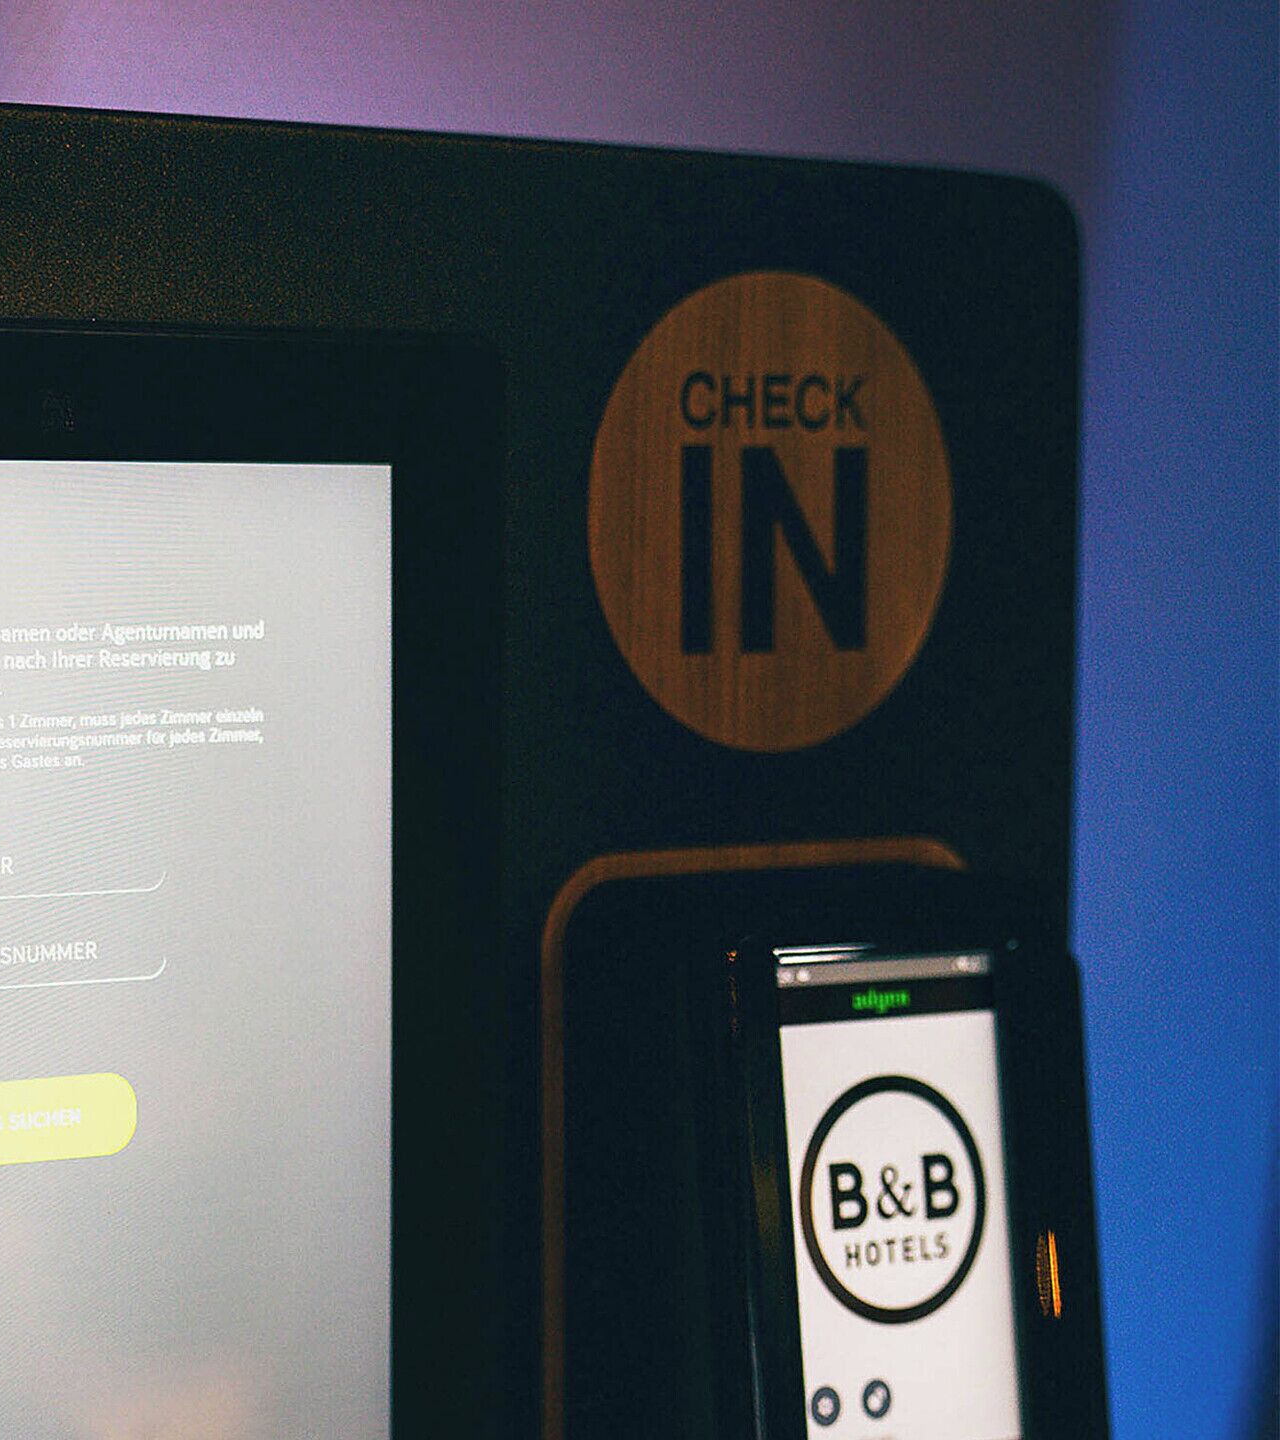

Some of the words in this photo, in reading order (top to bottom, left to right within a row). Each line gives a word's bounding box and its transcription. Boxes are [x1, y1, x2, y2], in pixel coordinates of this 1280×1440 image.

[680, 371, 867, 430] CHECK
[680, 444, 867, 655] IN
[55, 623, 96, 642] oder
[101, 622, 228, 646] Agenturnamen
[232, 620, 265, 640] und
[3, 651, 49, 669] nach
[53, 650, 94, 668] Ihrer
[99, 649, 211, 670] Reservierung
[215, 650, 236, 666] zu
[8, 714, 15, 729] 1
[20, 714, 77, 730] Zimmer,
[80, 713, 116, 727] muss
[120, 711, 157, 729] jedes
[160, 709, 213, 725] Zimmer
[215, 707, 264, 724] einzeln
[168, 730, 206, 748] jedes
[208, 728, 264, 745] Zimmer,
[11, 754, 60, 769] Gastes
[64, 753, 84, 768] an.
[829, 1152, 960, 1230] B&B
[845, 1232, 950, 1268] HOTELS
